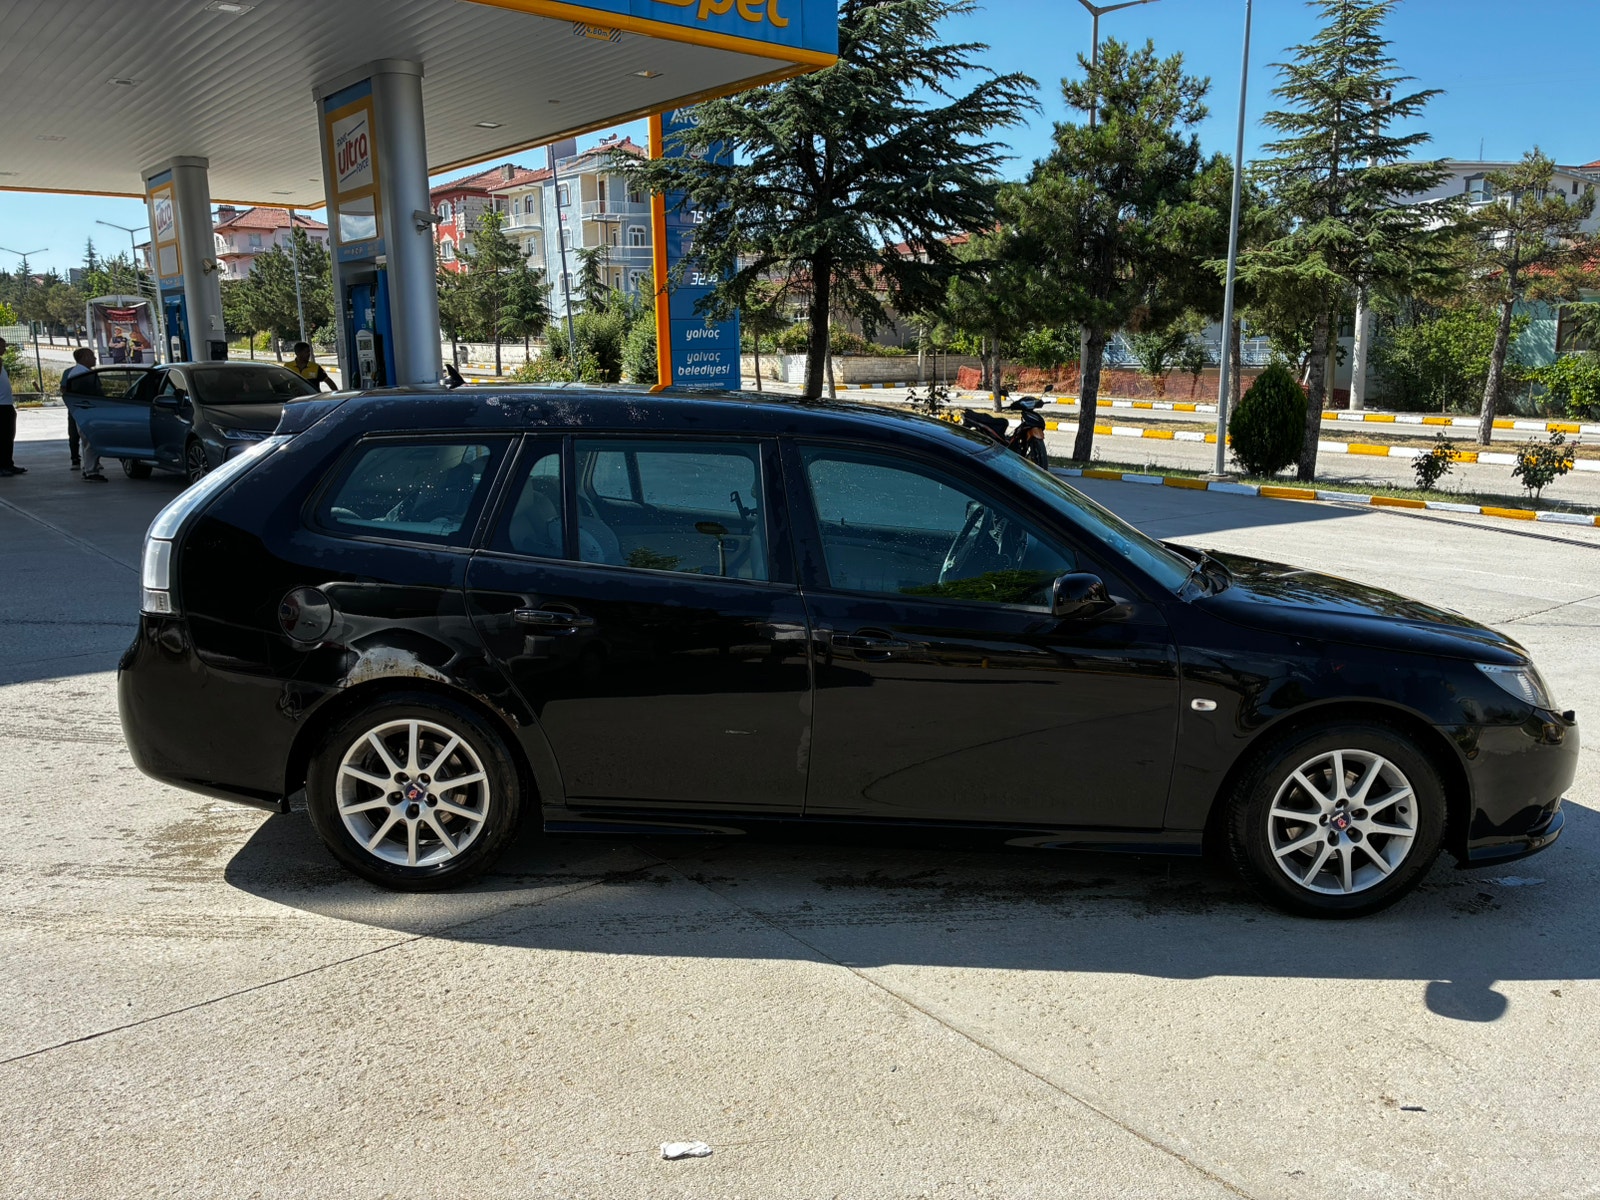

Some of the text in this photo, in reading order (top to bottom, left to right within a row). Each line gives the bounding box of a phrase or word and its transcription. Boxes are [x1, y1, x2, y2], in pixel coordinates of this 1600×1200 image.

[338, 132, 368, 175] ultra
[686, 328, 721, 341] yalvaç
[686, 351, 721, 365] yalvaç
[677, 364, 731, 377] belediyesi
